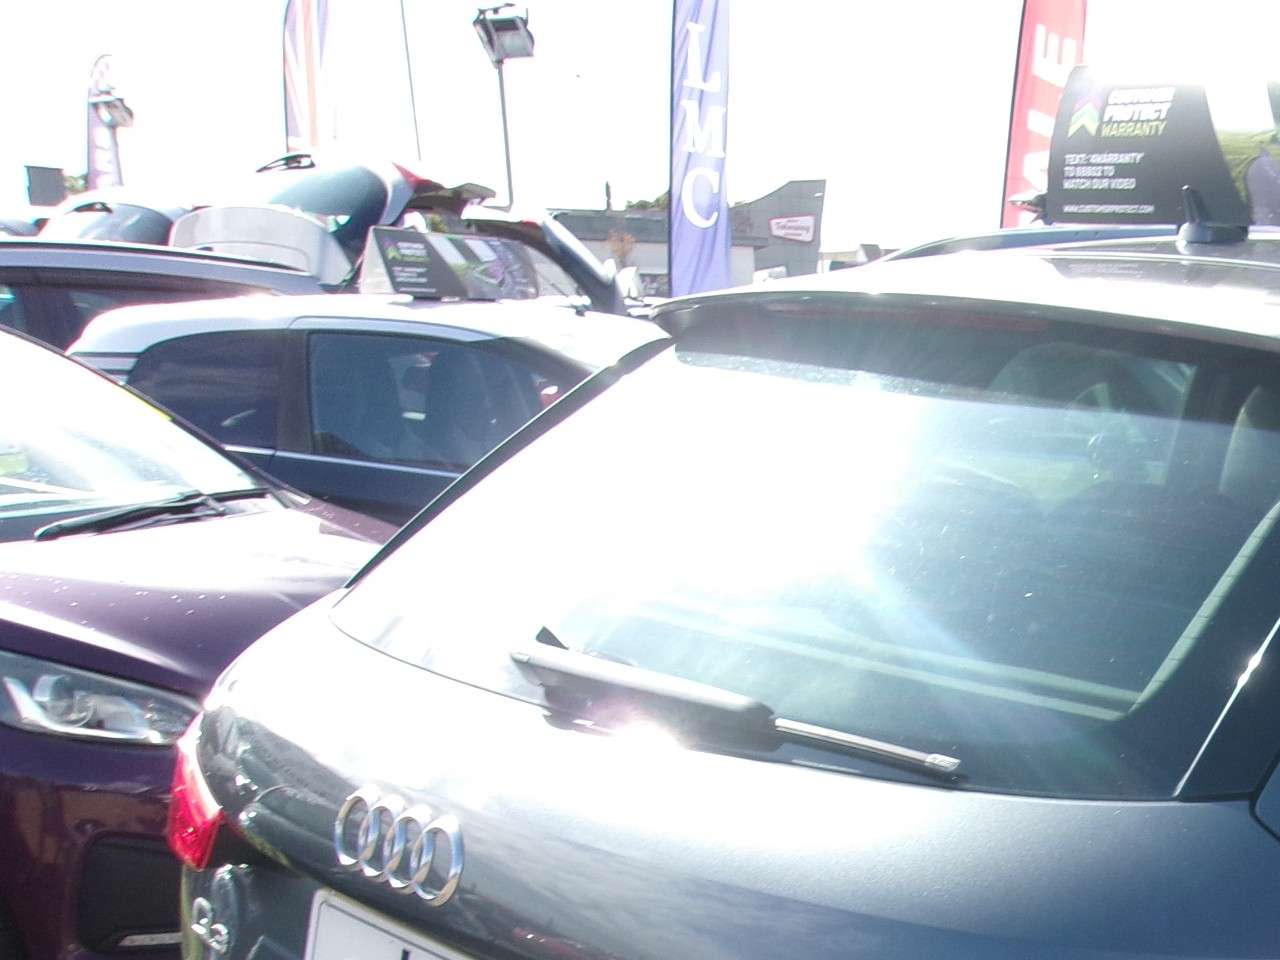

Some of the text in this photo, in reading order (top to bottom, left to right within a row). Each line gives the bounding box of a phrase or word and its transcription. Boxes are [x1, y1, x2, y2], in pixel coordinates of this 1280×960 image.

[681, 21, 727, 229] LMC
[1101, 120, 1167, 137] WARRANTY
[1110, 178, 1136, 189] VIDEO
